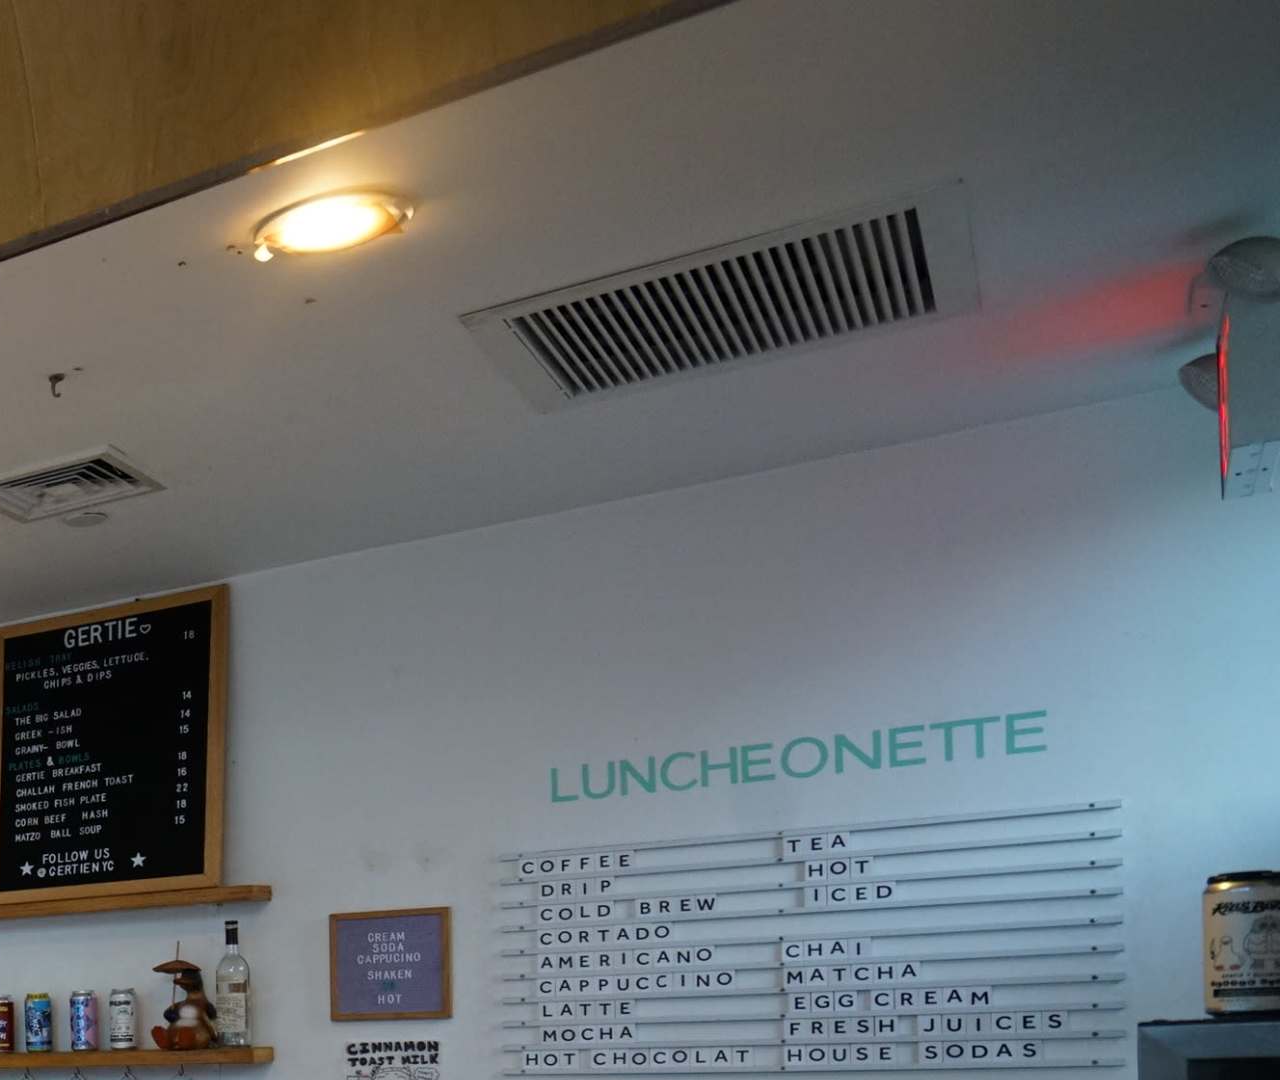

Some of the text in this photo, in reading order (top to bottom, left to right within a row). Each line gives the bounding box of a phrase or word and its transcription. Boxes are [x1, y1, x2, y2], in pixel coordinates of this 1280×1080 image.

[64, 618, 139, 649] GERTIE
[184, 630, 195, 639] 18
[44, 670, 112, 689] CHIPS DIPS
[15, 708, 82, 726] THE BIG SALAD
[15, 729, 43, 741] GREEK
[56, 738, 80, 750] BOWL
[549, 710, 1048, 803] LUNCHEONETTE
[16, 763, 102, 782] GERTIE BREAKFAST
[16, 774, 134, 797] CHALLAH FRENCH TOAST
[176, 784, 188, 793] 22
[15, 793, 107, 813] SMOKED FISH PLATE
[15, 809, 108, 828] CORN BEEF HASH
[15, 825, 102, 842] MATZO BALL SOUP
[787, 834, 847, 853] TEA
[43, 848, 110, 865] FOLLOW US
[521, 853, 631, 875] COFFEE
[808, 859, 871, 878] HOT
[541, 879, 612, 898] DRIP
[813, 884, 895, 903] ICED
[540, 897, 717, 922] COLD BREW
[368, 932, 405, 943] CREAM
[540, 924, 672, 946] CORTADO
[372, 944, 404, 952] SODA
[785, 941, 863, 959] CHAI
[541, 947, 713, 970] AMERICANO
[368, 970, 413, 980] SHAKEN
[540, 971, 733, 994] CAPPUCCINO
[786, 963, 918, 985] MATCHA
[377, 994, 402, 1005] HOT
[542, 1001, 632, 1017] LATTE
[795, 989, 991, 1011] EGG CREAM
[542, 1026, 634, 1042] MOCHA
[790, 1014, 1063, 1035] FRESH JUICES
[346, 1041, 440, 1055] CINNAMON
[787, 1042, 1038, 1063] HOUSE SODAS
[347, 1053, 439, 1066] TOAST MILK
[525, 1049, 751, 1067] HOT CHOCOLAT
